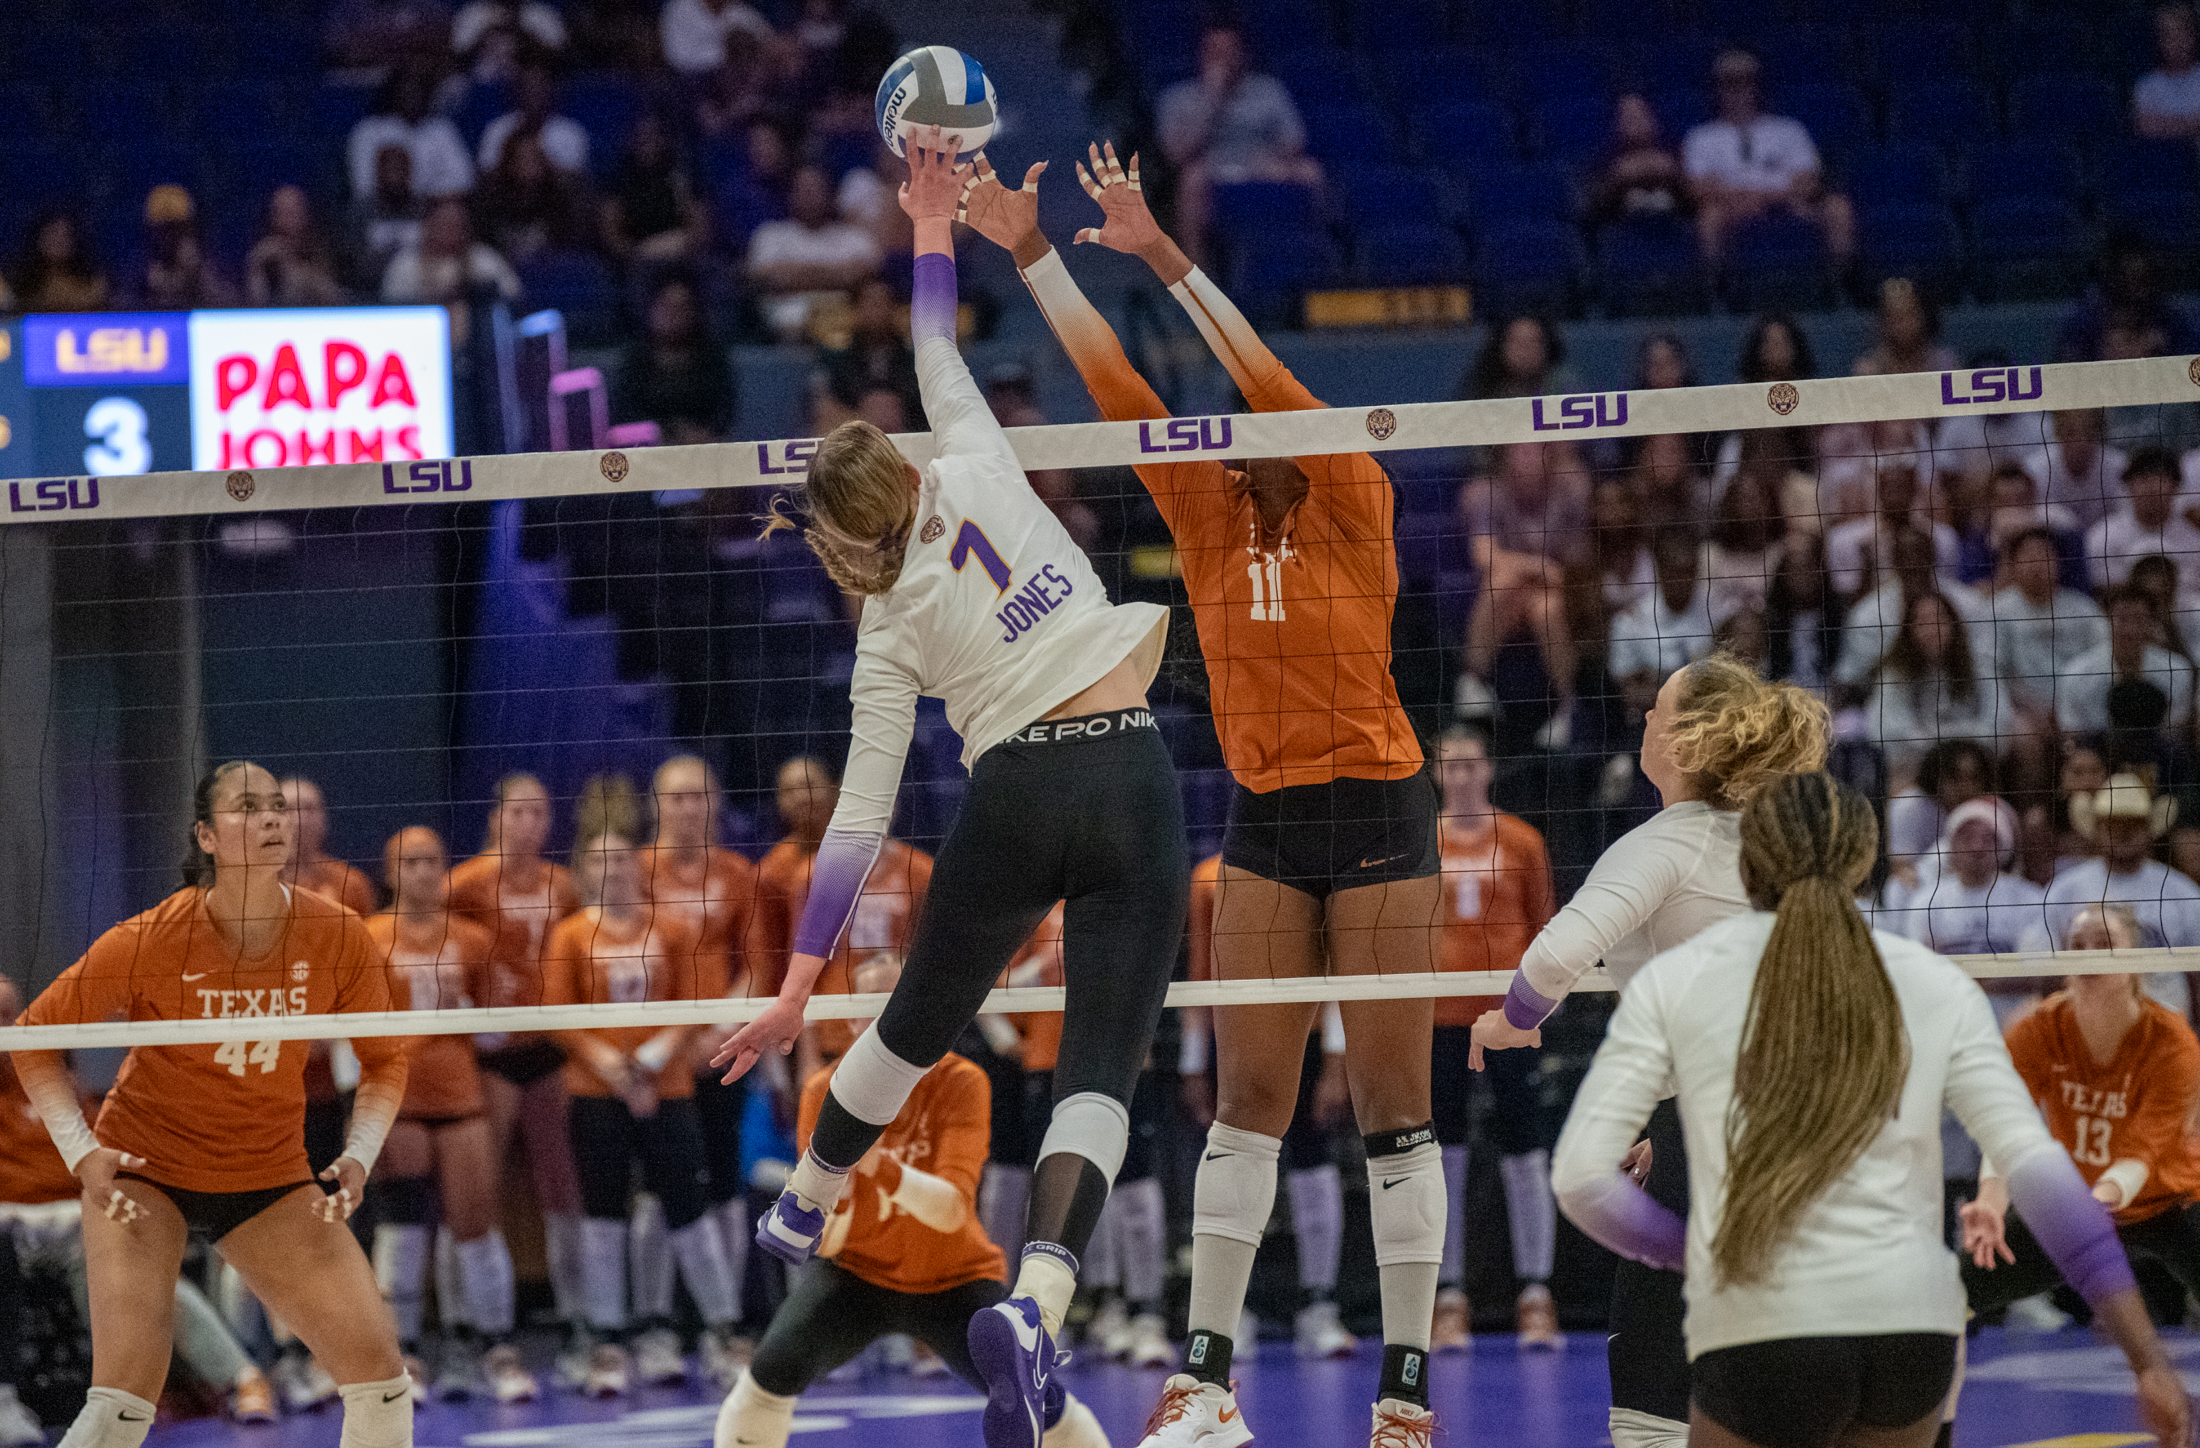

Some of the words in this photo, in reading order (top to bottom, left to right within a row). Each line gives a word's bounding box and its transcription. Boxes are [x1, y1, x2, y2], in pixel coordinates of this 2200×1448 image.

[883, 86, 907, 148] molten
[56, 328, 169, 373] LSU
[214, 338, 420, 412] PAPA
[1941, 366, 2042, 405] LSU
[1532, 393, 1628, 431] LSU
[84, 396, 152, 475] 3
[1139, 417, 1232, 453] LSU
[382, 460, 472, 494] LSU
[758, 441, 814, 474] LS
[9, 478, 100, 513] LSU
[948, 517, 1013, 601] 7
[996, 564, 1073, 643] JONES
[1247, 562, 1286, 621] 11
[197, 986, 307, 1018] TEXAS
[214, 1040, 282, 1077] 44
[2074, 1115, 2112, 1166] 13
[1036, 1244, 1067, 1256] GRIP
